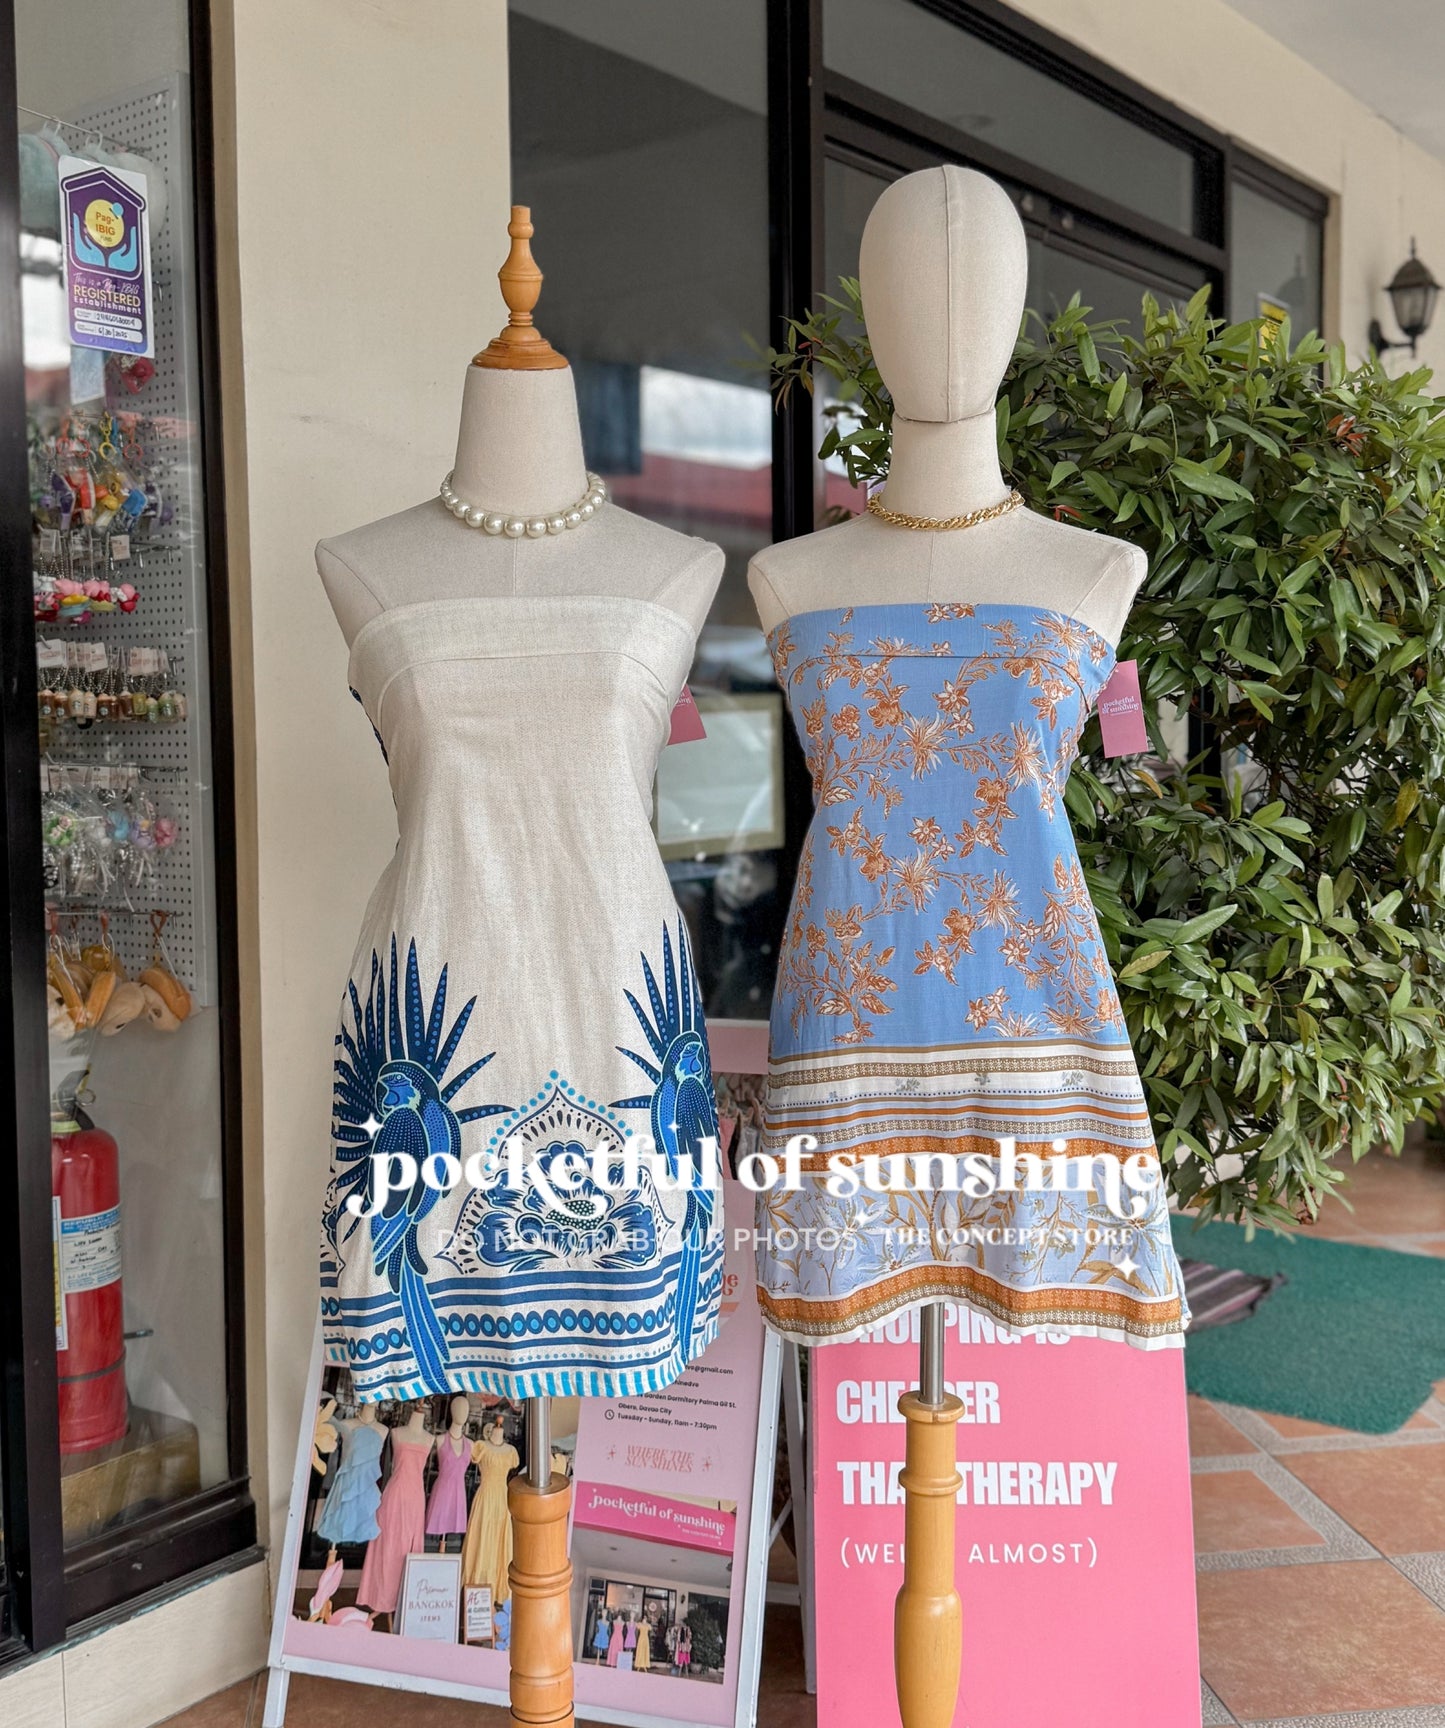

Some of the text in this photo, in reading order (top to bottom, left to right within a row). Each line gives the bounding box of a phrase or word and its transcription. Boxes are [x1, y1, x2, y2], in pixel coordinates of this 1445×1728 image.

[96, 211, 114, 225] Pag-
[96, 224, 115, 236] IBIG
[73, 284, 141, 307] REGISTERED
[73, 295, 142, 315] Establishment
[644, 1392, 667, 1401] Garden
[667, 1395, 698, 1405] Dormitory
[698, 1398, 719, 1407] Palma
[836, 1379, 1001, 1425] CHEER
[639, 1404, 659, 1413] Davao
[659, 1407, 672, 1415] City
[618, 1412, 643, 1423] Tuesday
[648, 1415, 674, 1426] Sunday,
[694, 1421, 718, 1431] 7:30pm
[627, 1444, 695, 1463] WHERE THE
[625, 1455, 693, 1473] SUN SHINES
[836, 1461, 1118, 1505] THA THERAPY
[588, 1494, 657, 1518] pocketful
[659, 1508, 674, 1520] of
[673, 1512, 726, 1536] sunshine
[968, 1537, 1098, 1568] ALMOST)
[408, 1600, 454, 1610] BANGKOK
